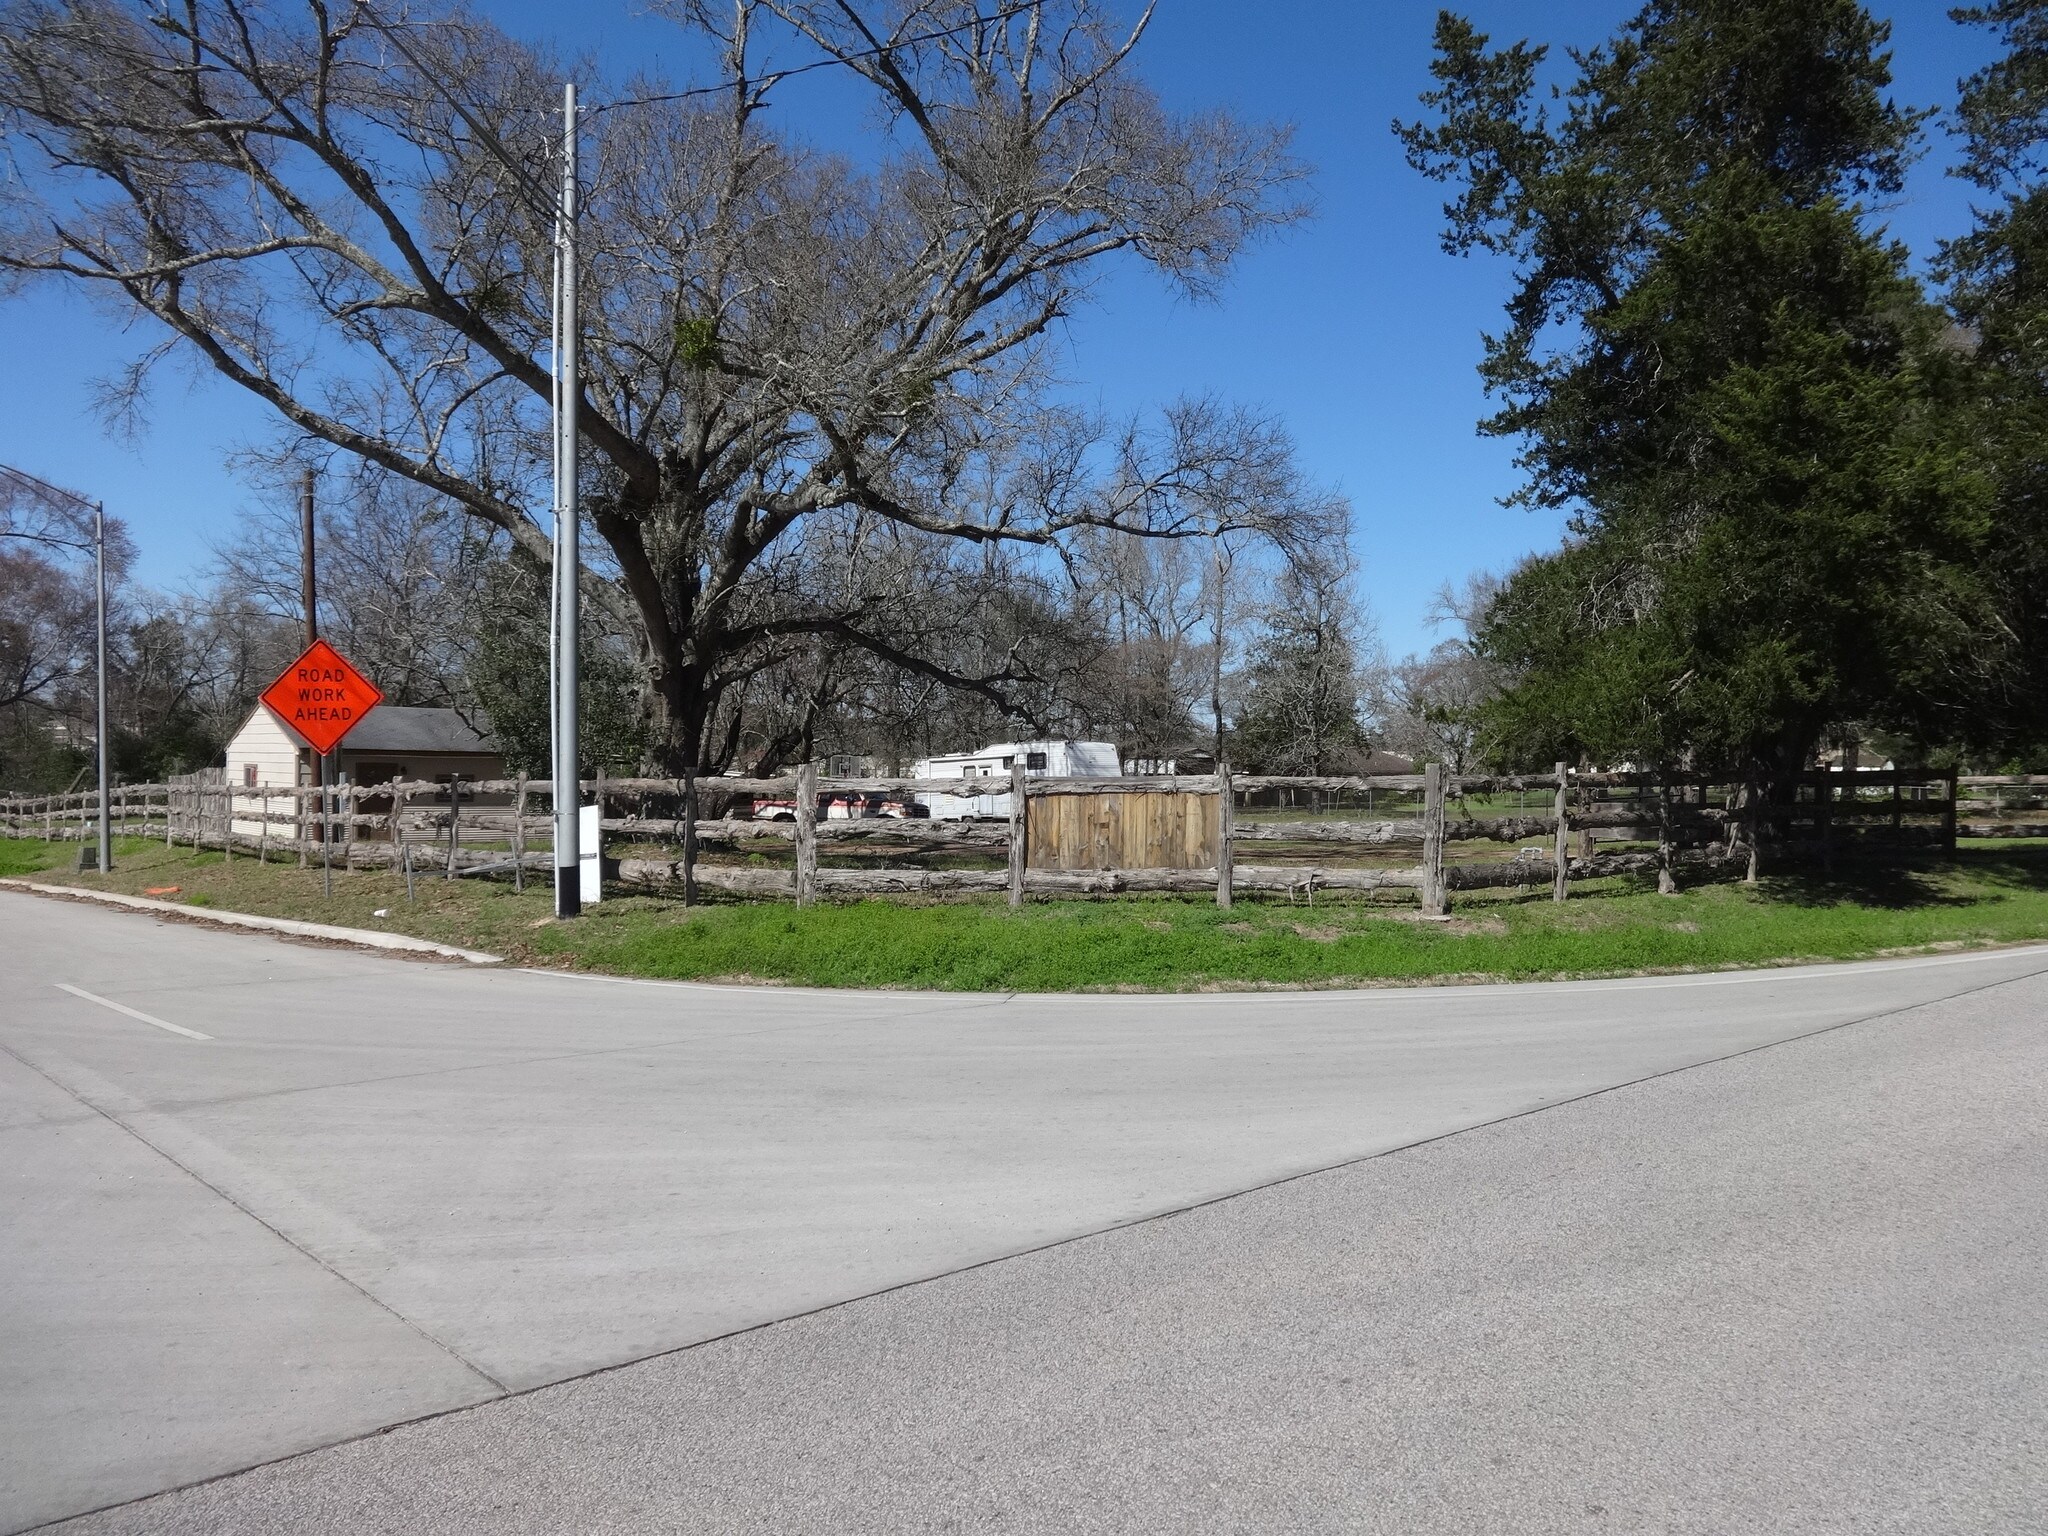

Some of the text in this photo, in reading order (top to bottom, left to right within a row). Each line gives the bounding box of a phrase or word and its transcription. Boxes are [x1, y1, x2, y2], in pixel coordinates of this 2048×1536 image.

[298, 669, 345, 682] ROAD
[298, 688, 345, 701] WORK
[295, 707, 352, 720] AHEAD
